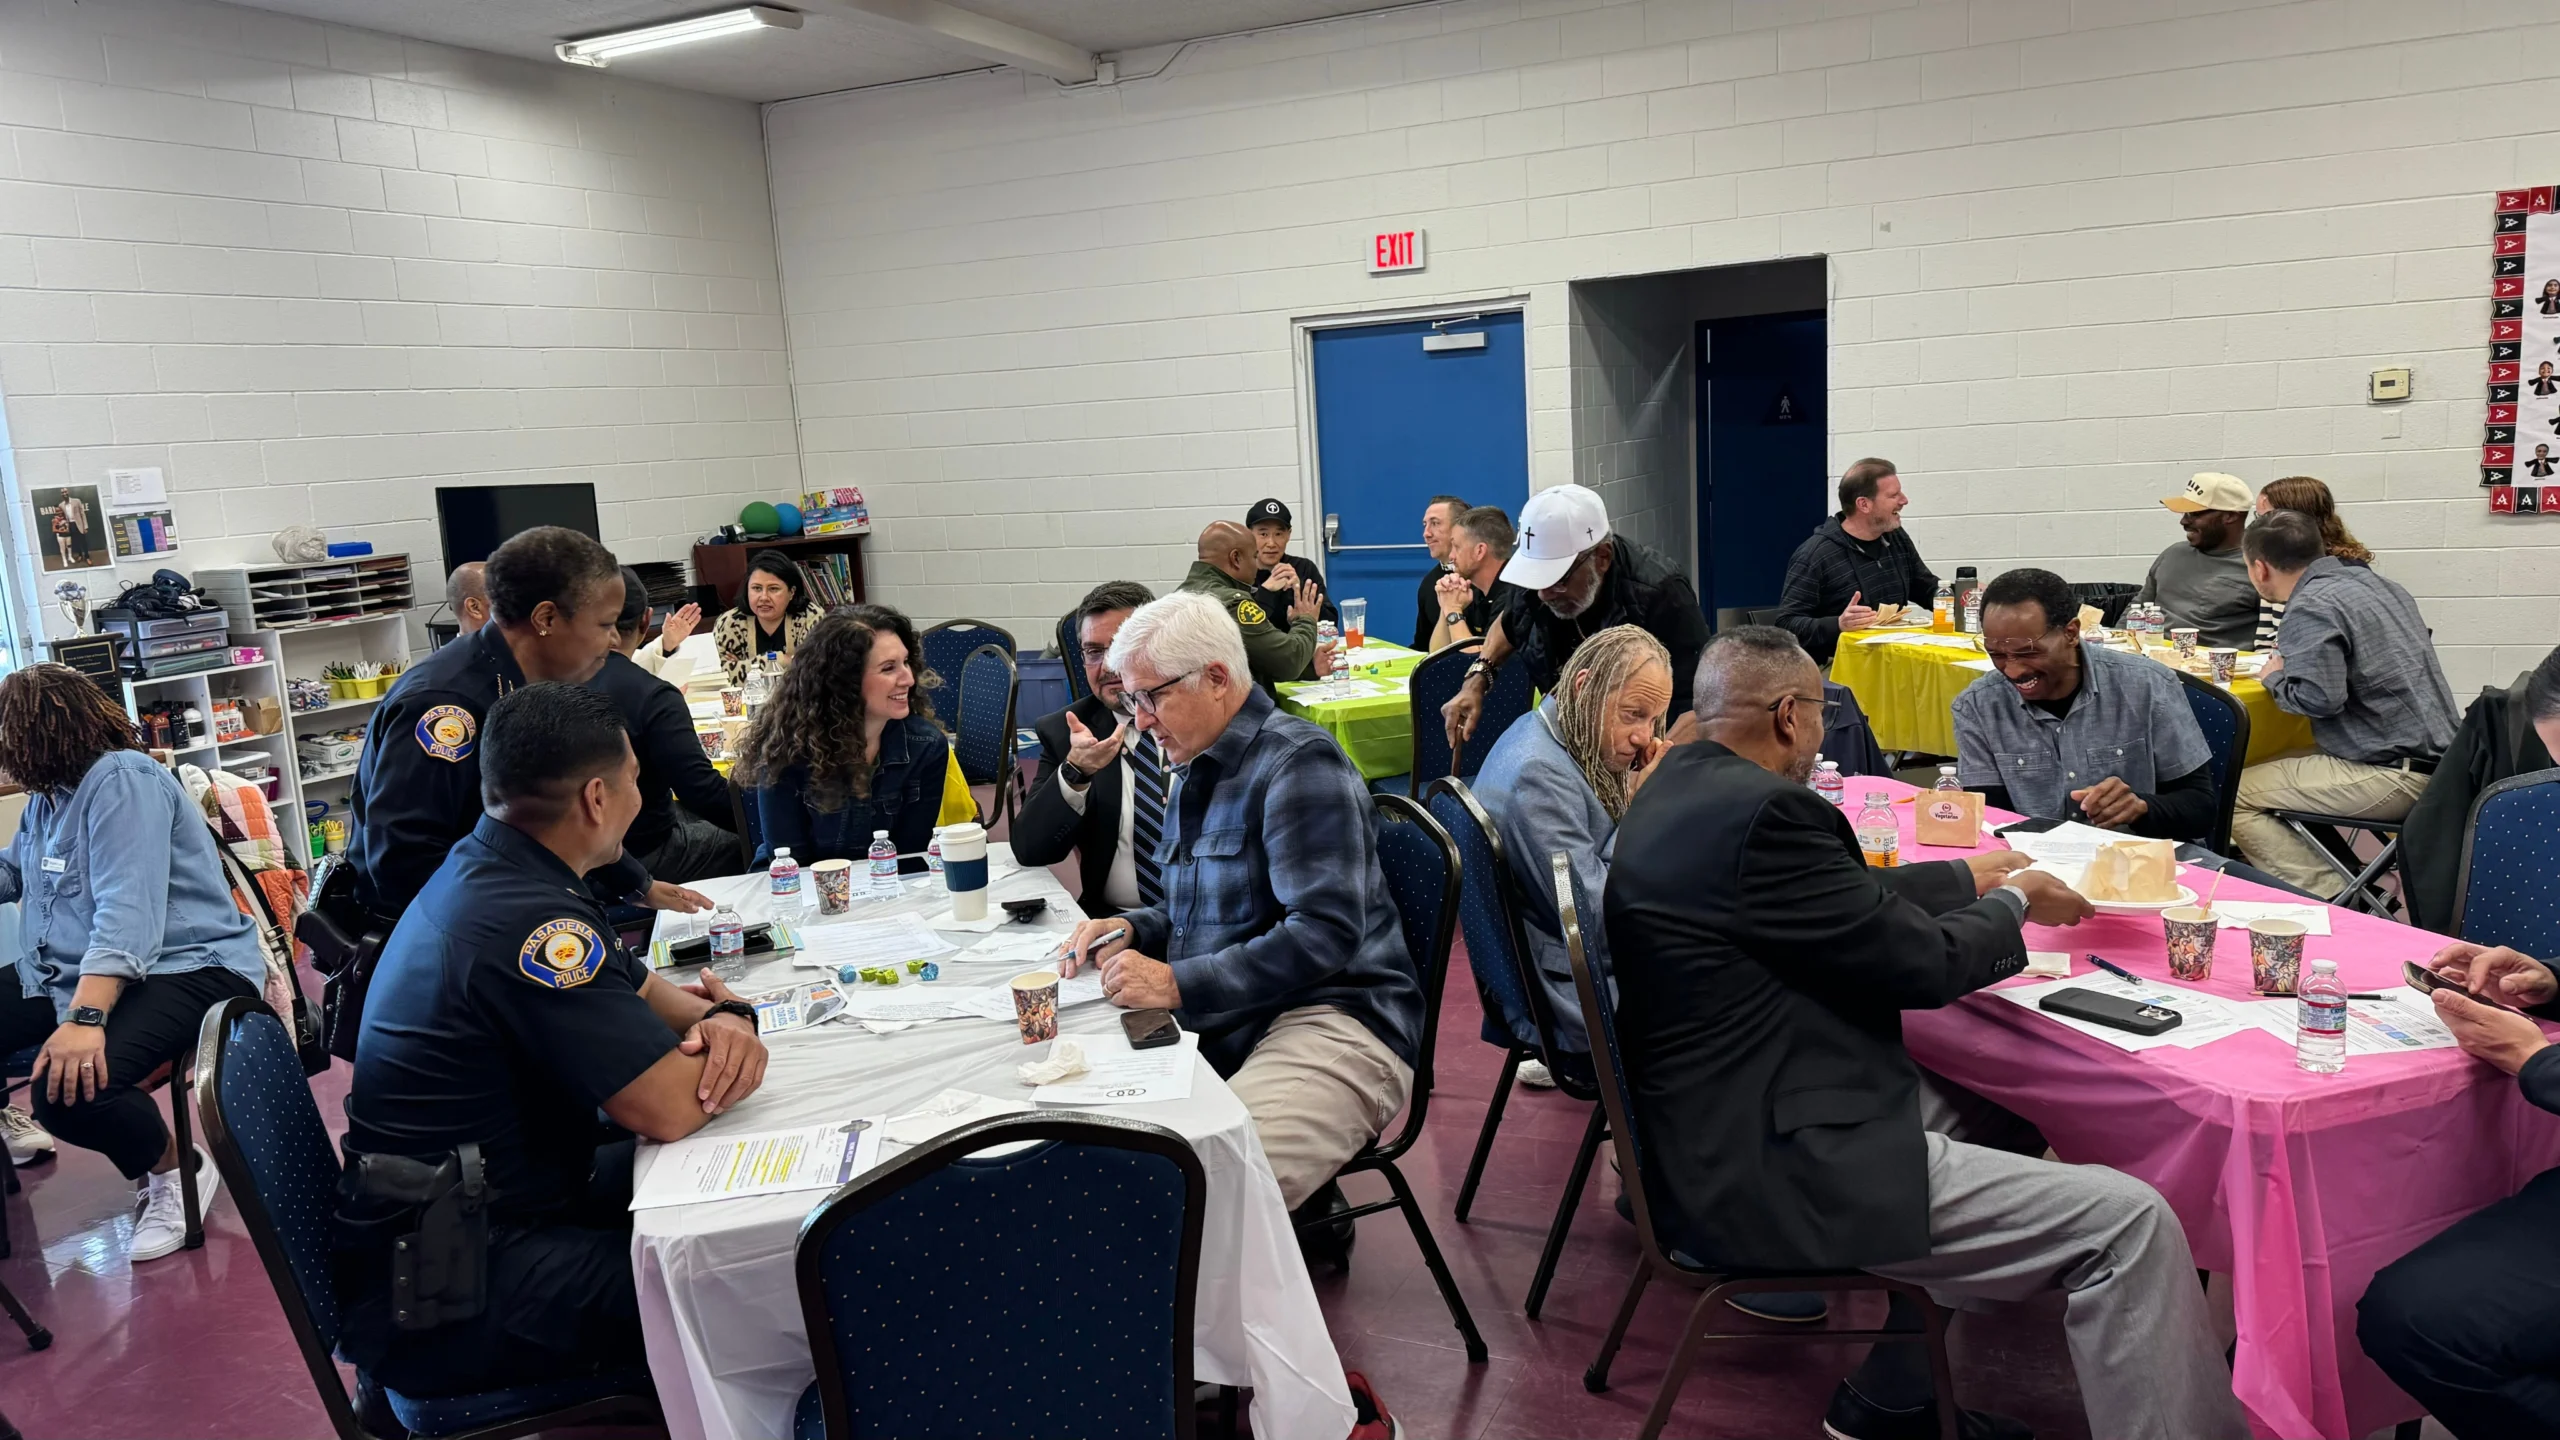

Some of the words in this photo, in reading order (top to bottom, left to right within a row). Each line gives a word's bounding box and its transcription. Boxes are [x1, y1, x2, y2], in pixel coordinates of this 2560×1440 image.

[2506, 196, 2520, 207] A
[2533, 194, 2546, 206] A
[2505, 217, 2519, 229] A
[1376, 231, 1415, 268] EXIT
[2504, 239, 2518, 250] A
[2503, 261, 2517, 272] A
[2502, 282, 2516, 293] A
[2501, 304, 2515, 314] A
[2500, 325, 2514, 336] A
[2499, 346, 2513, 357] A
[2498, 367, 2512, 378] A
[2497, 388, 2511, 399] A
[2495, 409, 2509, 419] A
[2493, 430, 2508, 440] A
[2491, 451, 2506, 460] A
[2490, 471, 2504, 481] A
[2496, 493, 2508, 505] A
[2521, 493, 2533, 506] A
[2546, 493, 2558, 505] A
[430, 743, 459, 760] POLICE
[1934, 812, 1959, 820] Vegetarian
[524, 922, 594, 955] PASADENA
[554, 966, 590, 987] POLICE
